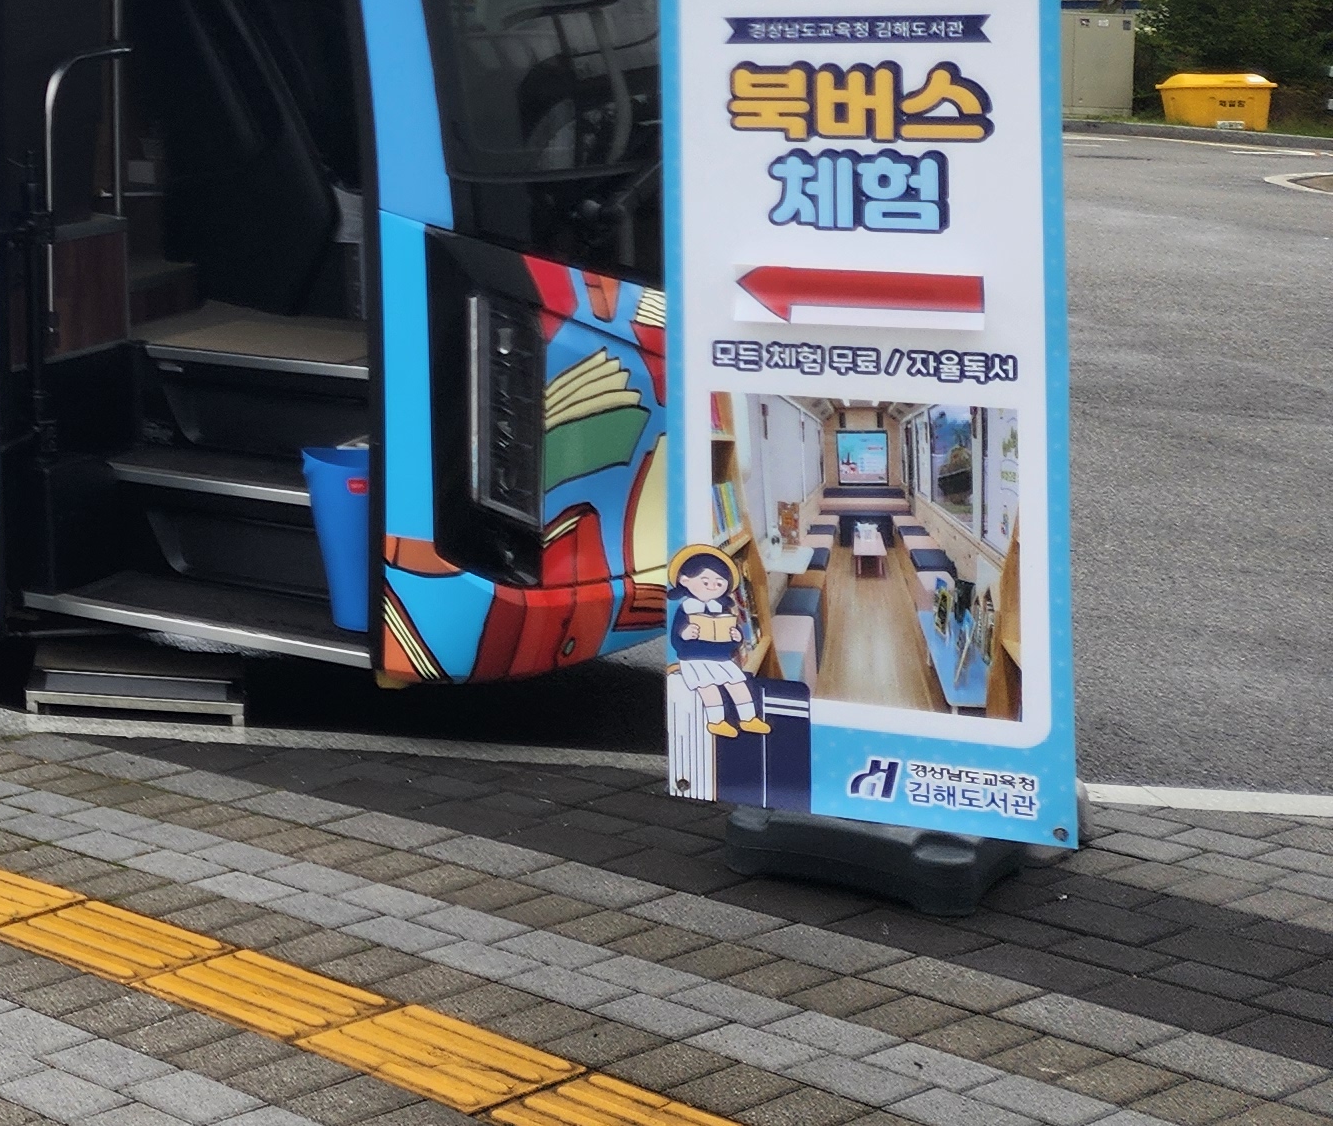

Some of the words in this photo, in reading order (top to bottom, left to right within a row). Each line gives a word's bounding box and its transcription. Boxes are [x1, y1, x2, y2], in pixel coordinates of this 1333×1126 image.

[748, 21, 870, 40] 경상남도교육청
[875, 20, 965, 38] 김해도서관
[727, 60, 995, 143] 북버스
[768, 148, 950, 234] 체험
[712, 340, 763, 372] 모든
[765, 342, 826, 375] 체험
[829, 346, 881, 376] 무료
[907, 349, 1019, 385] 자율독서
[909, 762, 1036, 792] 경상남도교육청
[908, 780, 1037, 818] 김해도서관
